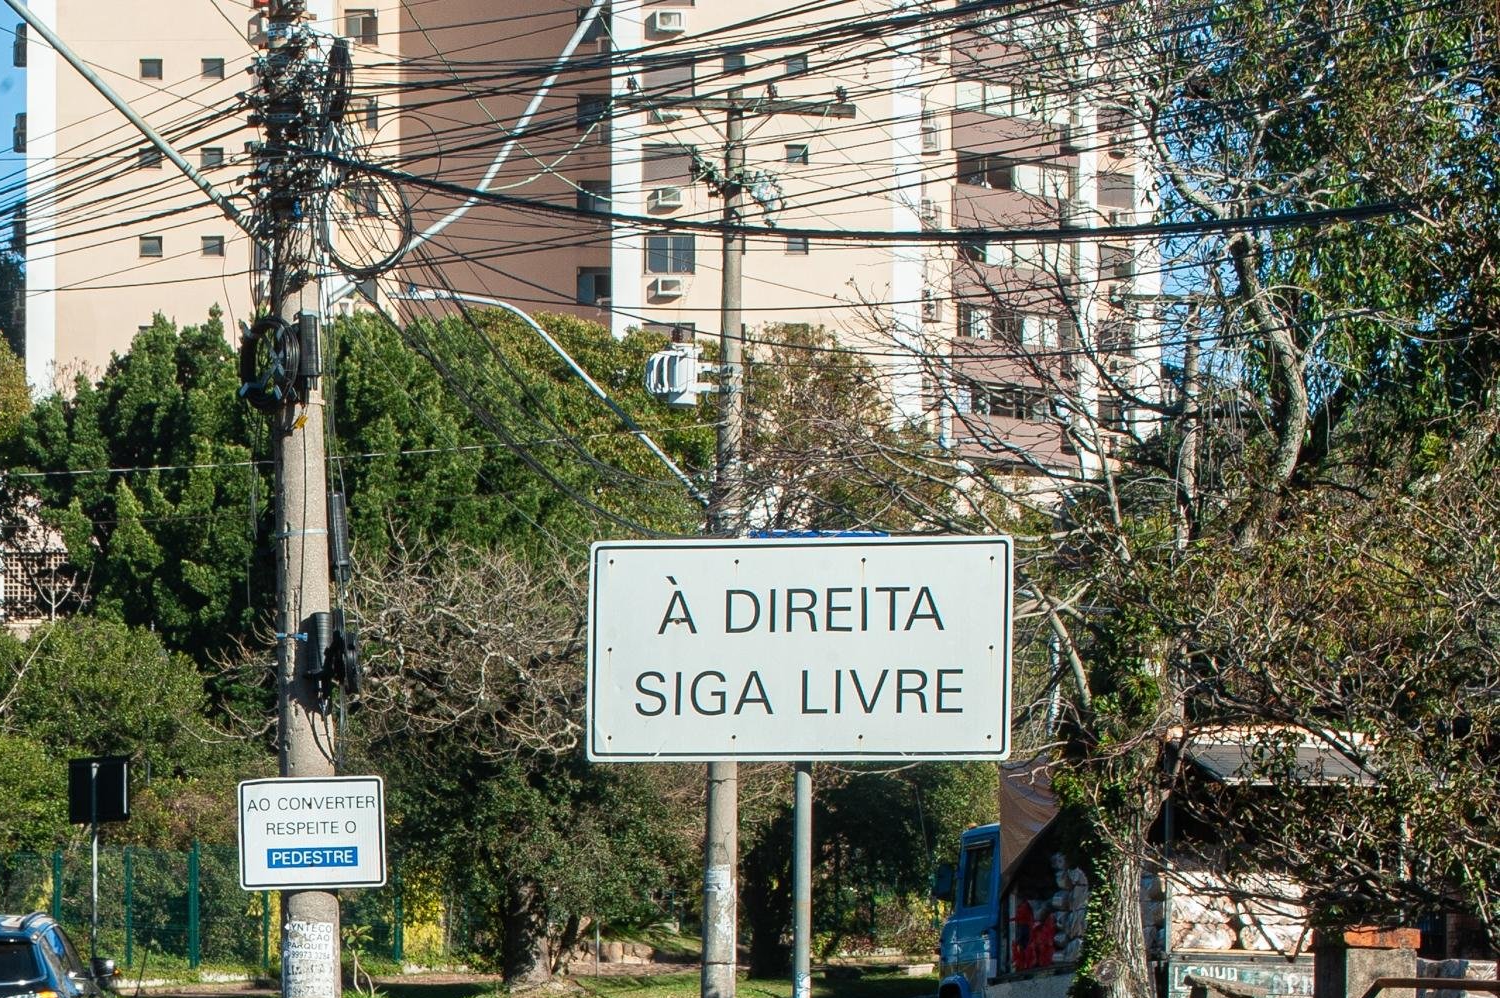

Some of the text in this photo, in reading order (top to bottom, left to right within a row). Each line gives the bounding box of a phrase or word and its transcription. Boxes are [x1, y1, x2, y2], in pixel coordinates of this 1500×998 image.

[658, 575, 945, 635] À DIREITA
[634, 669, 964, 717] SIGA LIVRE
[247, 795, 376, 812] AO CONVERTER
[266, 820, 357, 835] RESPEITE O
[272, 849, 354, 865] PEDESTRE
